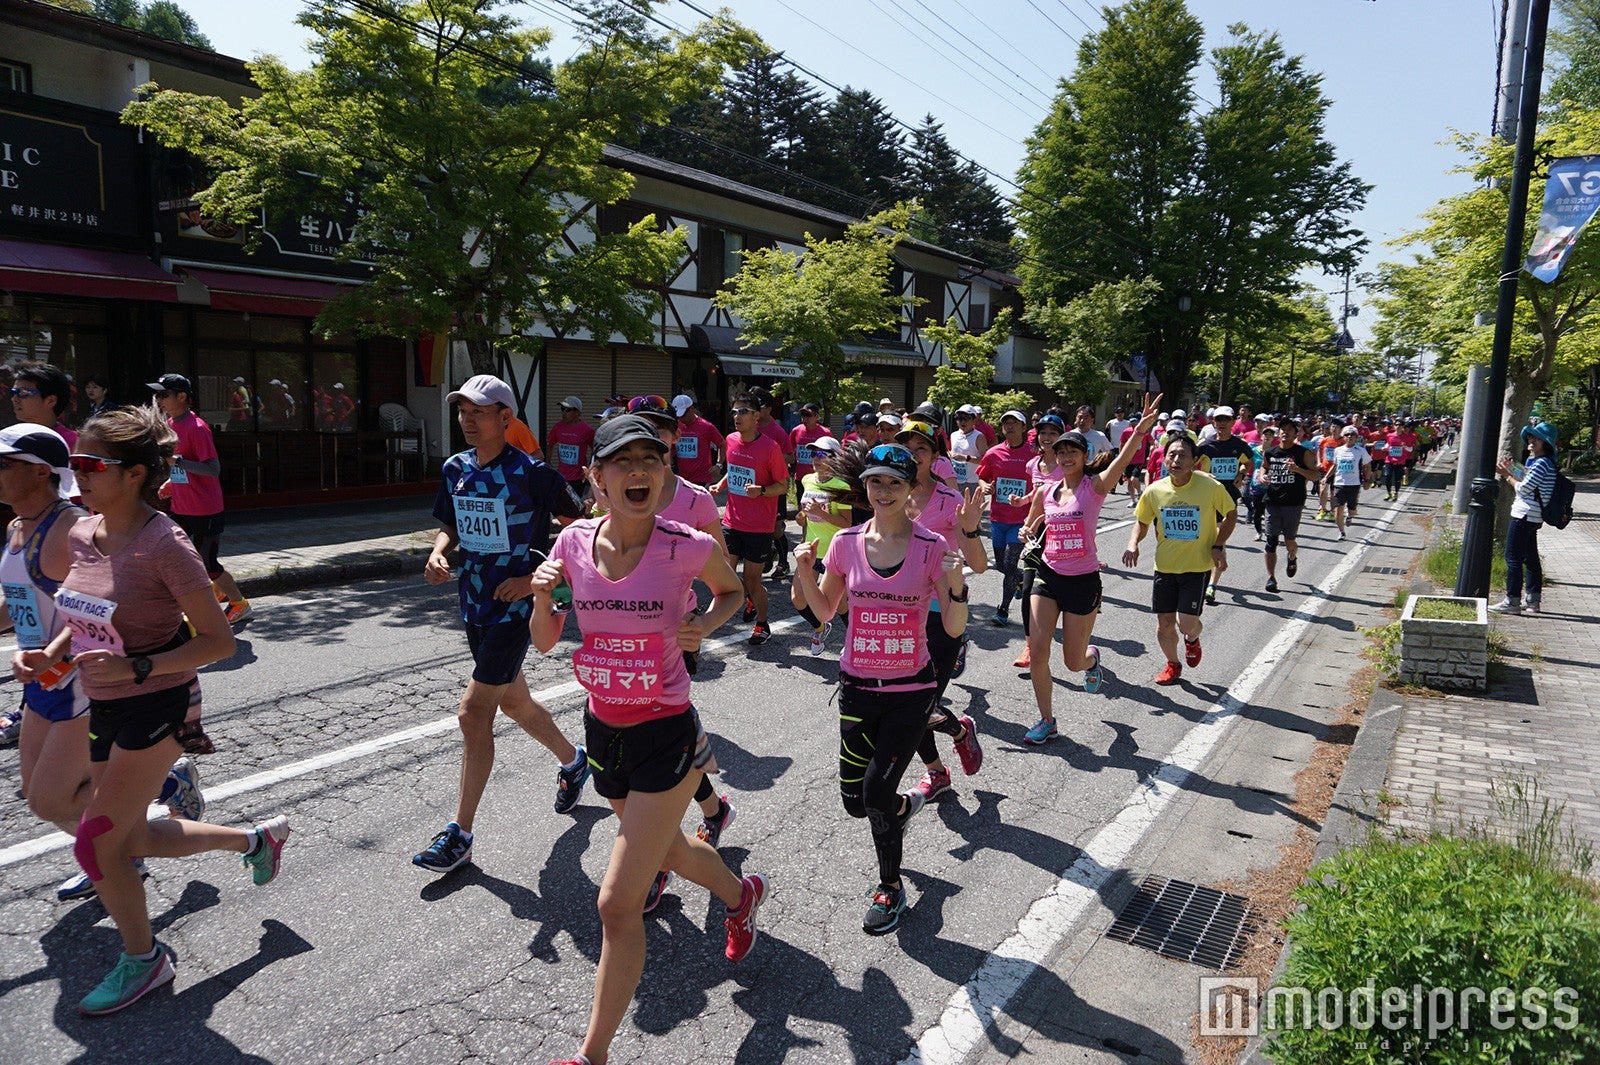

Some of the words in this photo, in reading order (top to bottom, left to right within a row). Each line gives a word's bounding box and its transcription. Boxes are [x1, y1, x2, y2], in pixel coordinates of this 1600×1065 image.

[457, 499, 496, 513] 長野日産
[457, 515, 501, 538] B2401
[1164, 519, 1199, 532] A1696
[878, 592, 903, 602] GIRLS
[64, 597, 86, 612] BOAT
[84, 602, 108, 618] RACE
[605, 599, 637, 612] GIRLS
[638, 600, 664, 612] RUN
[860, 611, 907, 625] GUEST
[856, 627, 876, 636] TOKYO
[876, 629, 897, 637] GIRLS
[593, 637, 649, 653] GUEST
[853, 636, 881, 654] 梅本
[883, 637, 916, 655] 静香
[579, 653, 606, 666] TOKYO
[606, 659, 633, 668] GIRLS
[634, 659, 655, 668] RUN
[615, 671, 658, 691] マヤ
